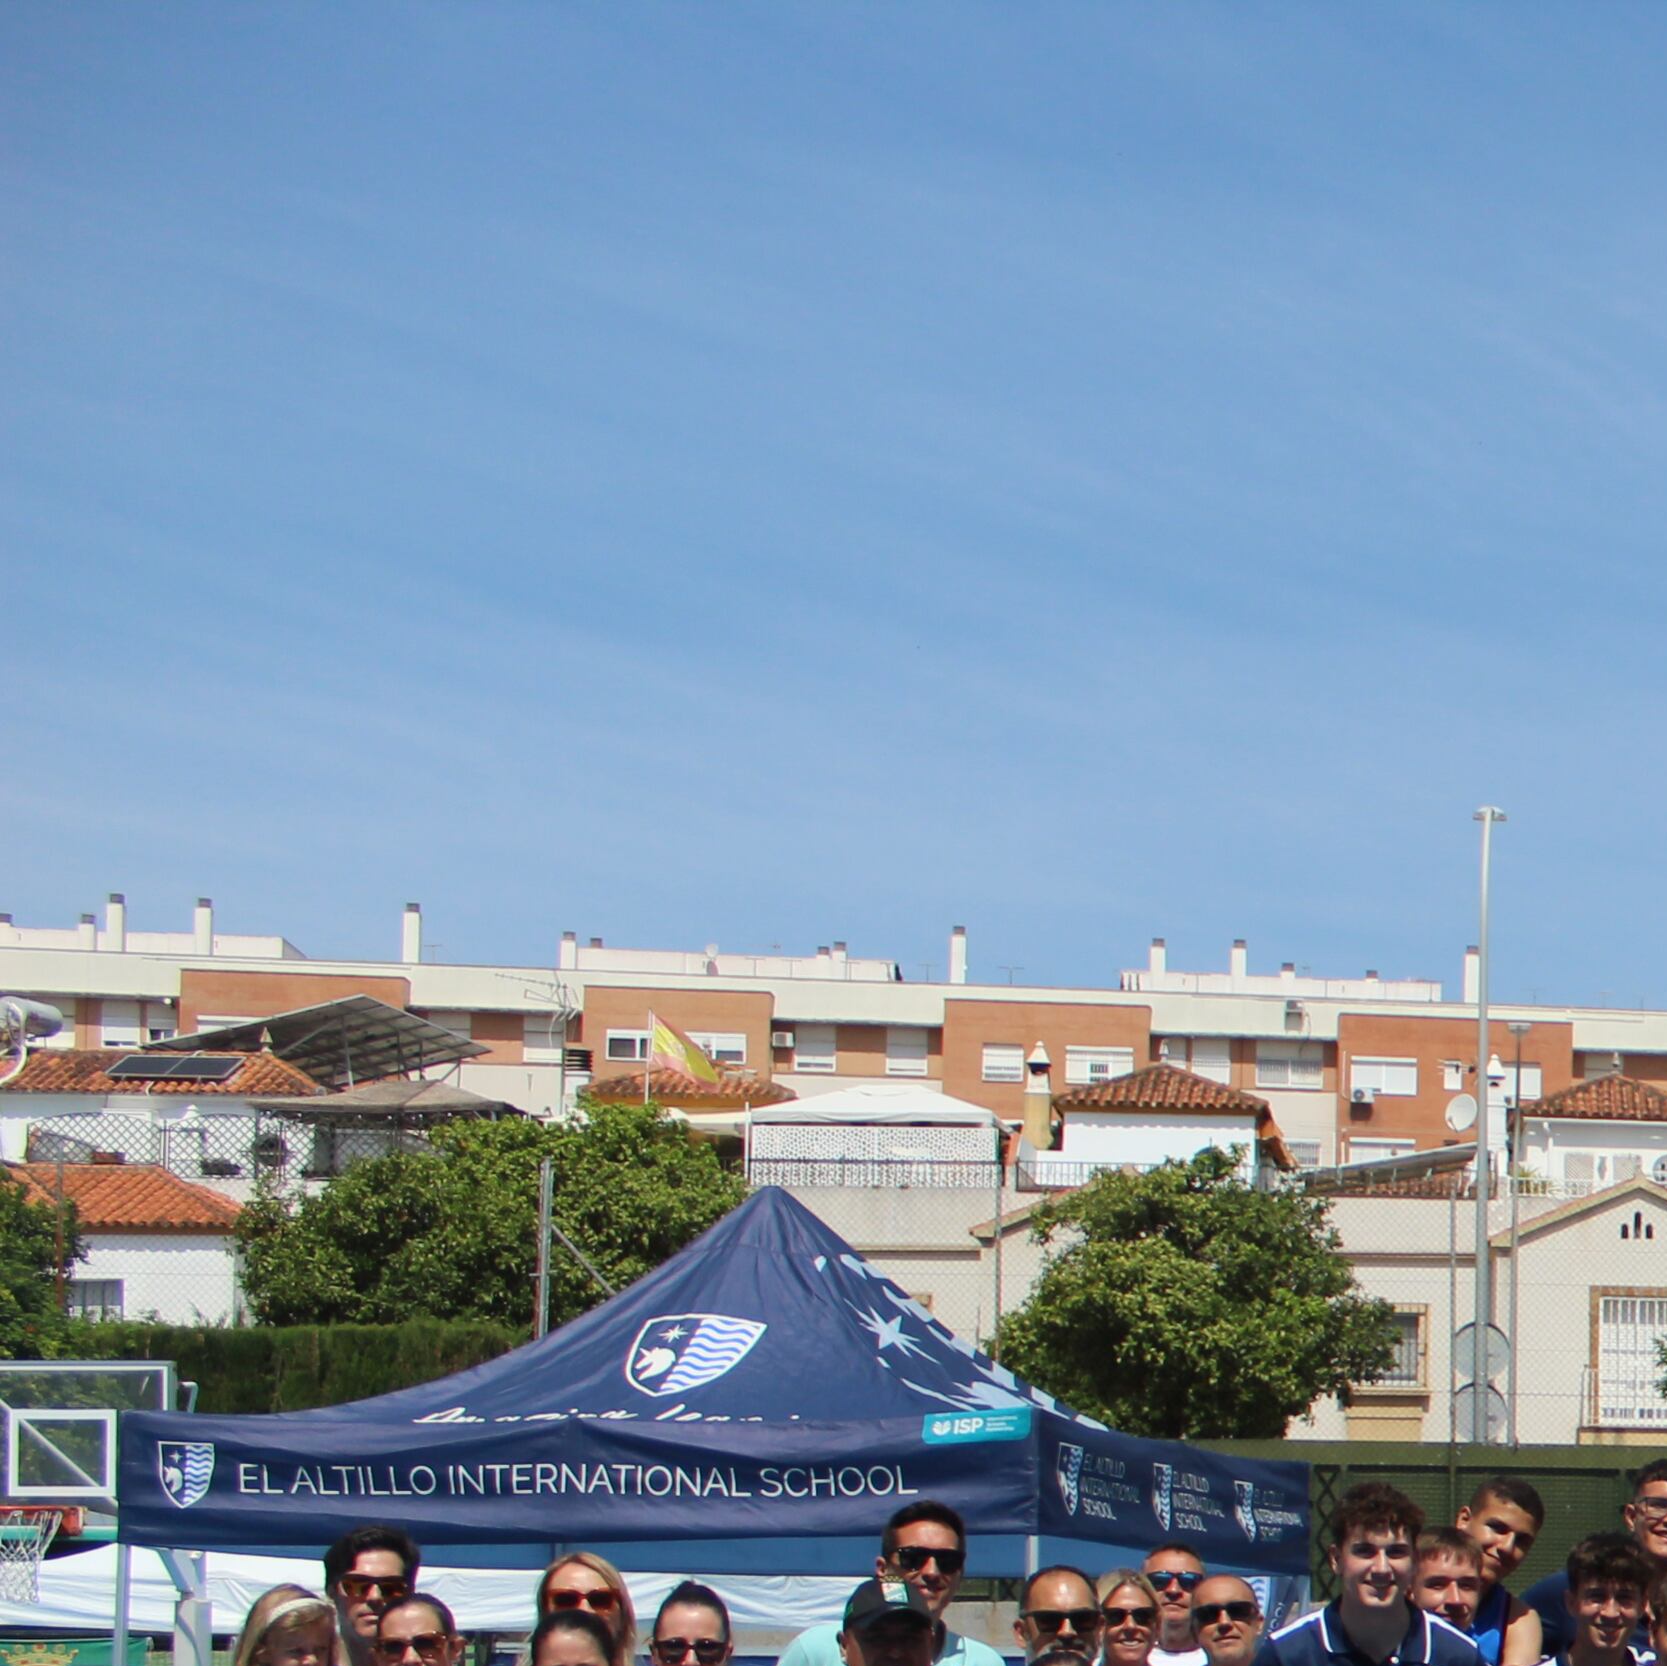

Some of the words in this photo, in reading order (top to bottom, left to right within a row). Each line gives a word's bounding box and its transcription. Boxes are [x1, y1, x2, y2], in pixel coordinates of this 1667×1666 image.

[953, 1417, 984, 1435] ISP
[239, 1463, 284, 1494] EL
[289, 1464, 437, 1496] ALTILLO
[448, 1463, 752, 1497] INTERNATIONAL
[759, 1465, 919, 1498] SCHOOL
[1083, 1498, 1118, 1520] SCHOOL
[1175, 1512, 1208, 1532] SCHOOL
